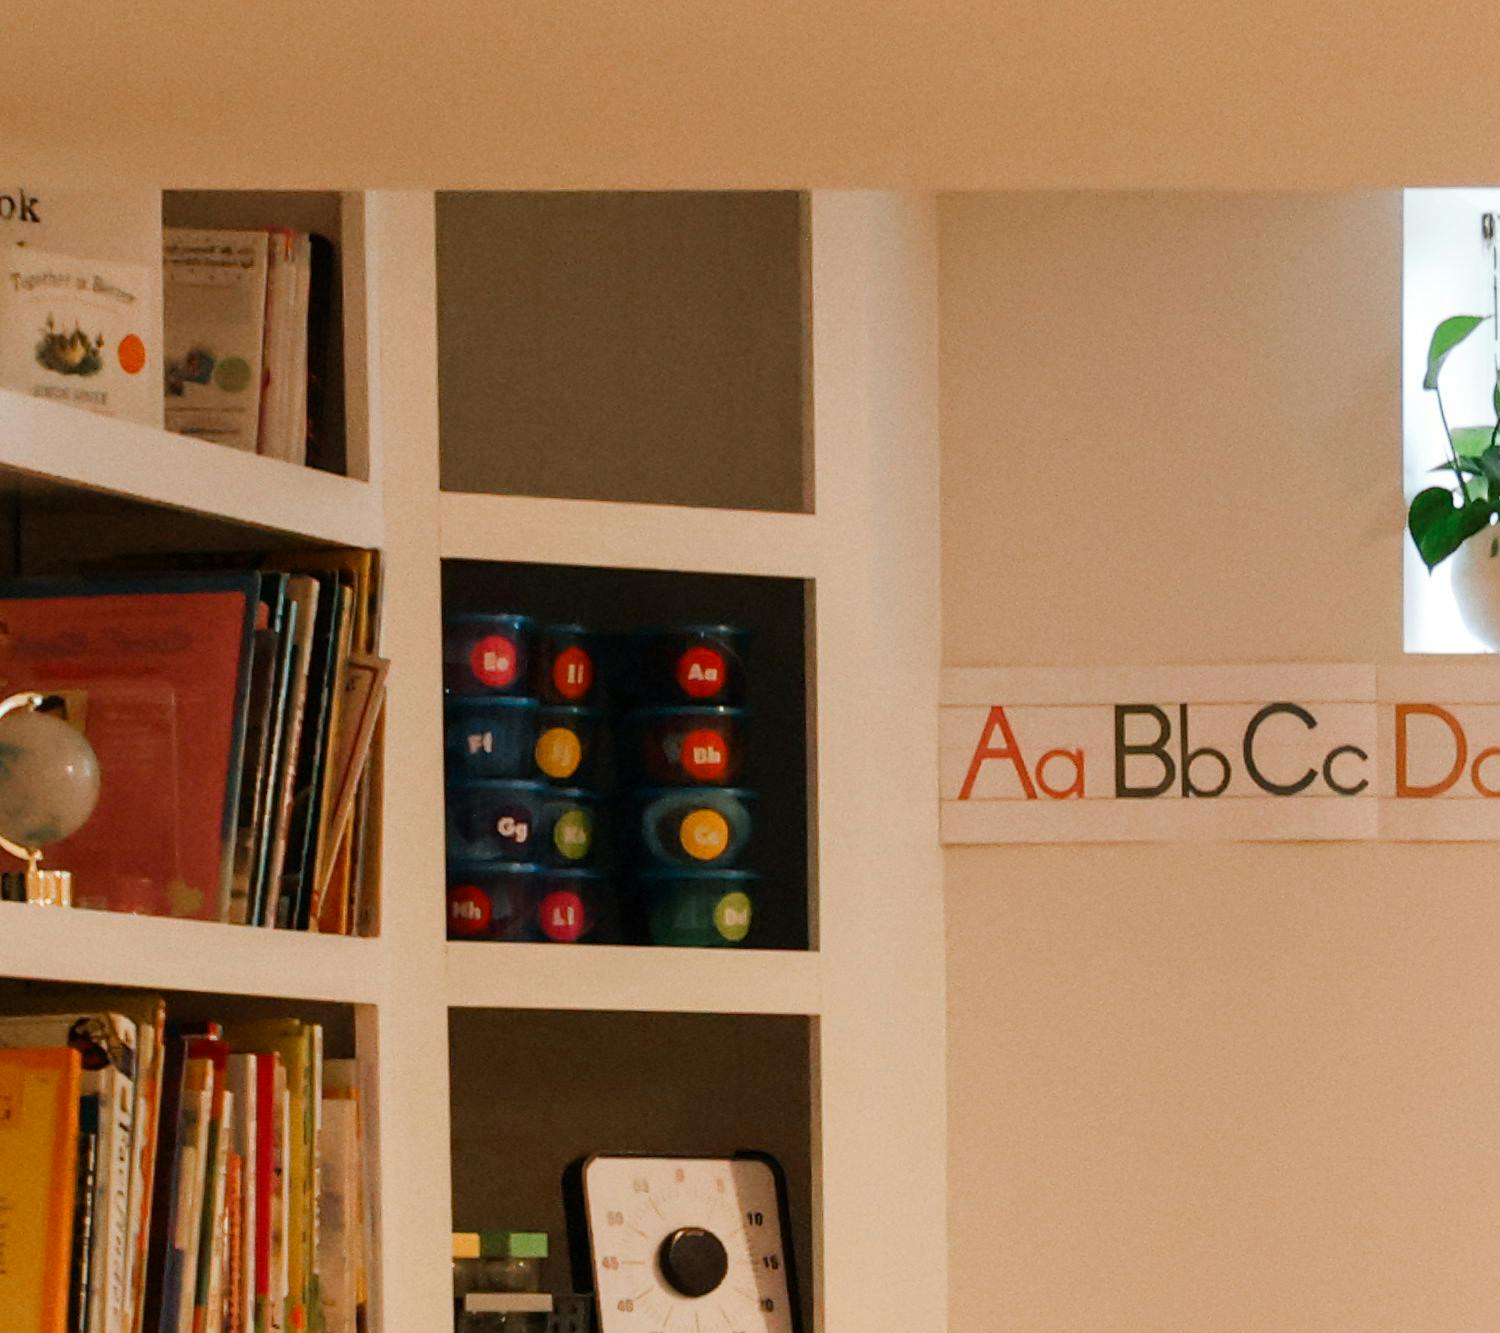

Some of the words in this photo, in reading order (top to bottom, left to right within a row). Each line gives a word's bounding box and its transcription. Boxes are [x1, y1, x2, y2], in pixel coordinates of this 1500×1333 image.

[957, 704, 1086, 800] Aa
[1111, 703, 1232, 800] Bb
[1240, 702, 1369, 800] Cc
